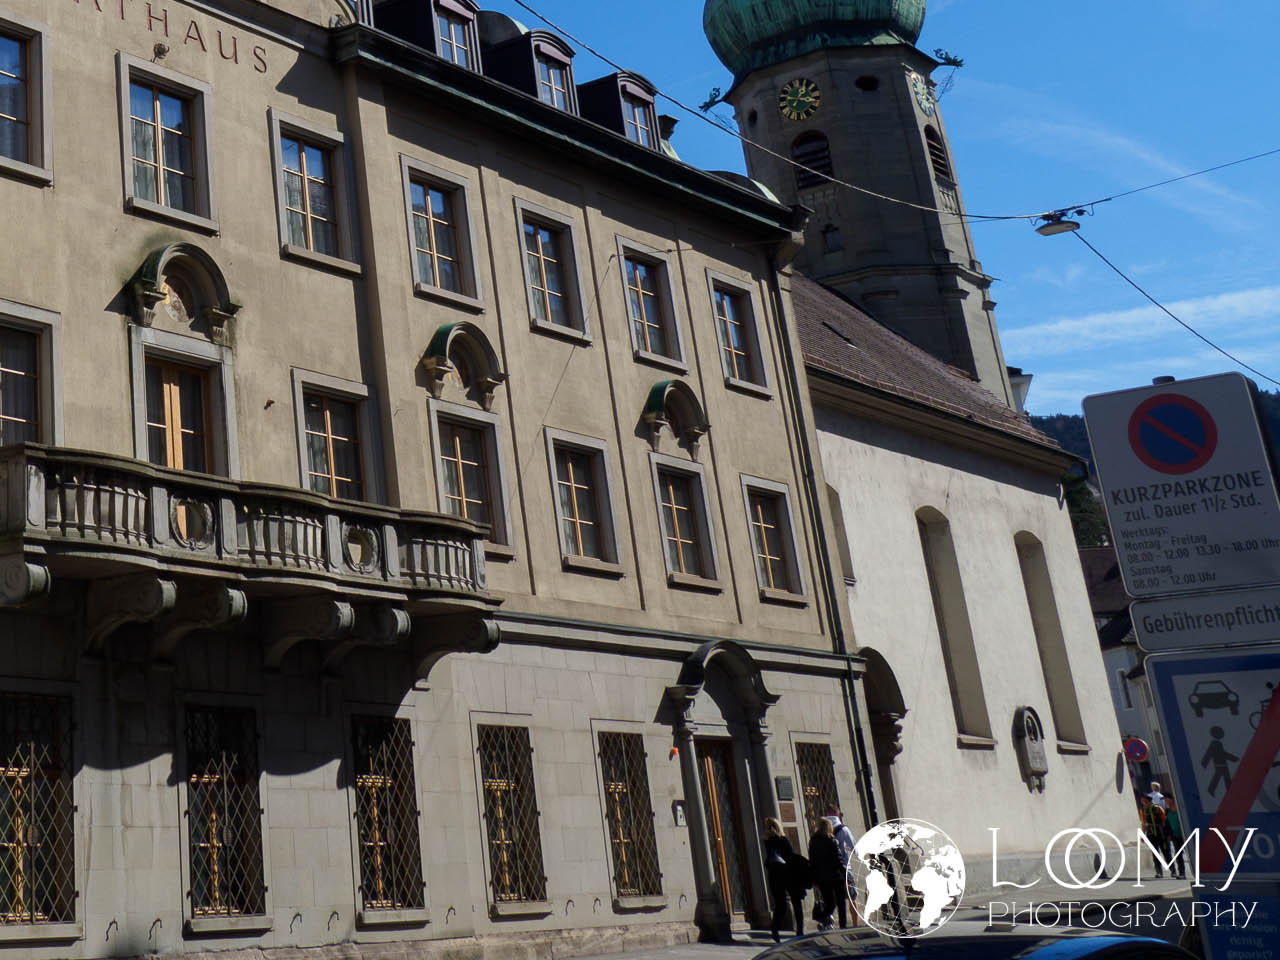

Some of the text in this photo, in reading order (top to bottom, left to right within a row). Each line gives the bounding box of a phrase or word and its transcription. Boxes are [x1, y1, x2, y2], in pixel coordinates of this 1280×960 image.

[1111, 470, 1265, 505] KURZPARKZONE
[1123, 507, 1149, 522] zul.
[1154, 500, 1197, 518] Dauer
[1230, 490, 1261, 509] Std.
[1124, 540, 1160, 551] Montag
[1171, 534, 1207, 546] Freitag
[1164, 548, 1189, 560] 12.00
[1130, 565, 1173, 576] Samstag
[1170, 574, 1195, 585] 12.00
[1198, 571, 1216, 582] Uhr
